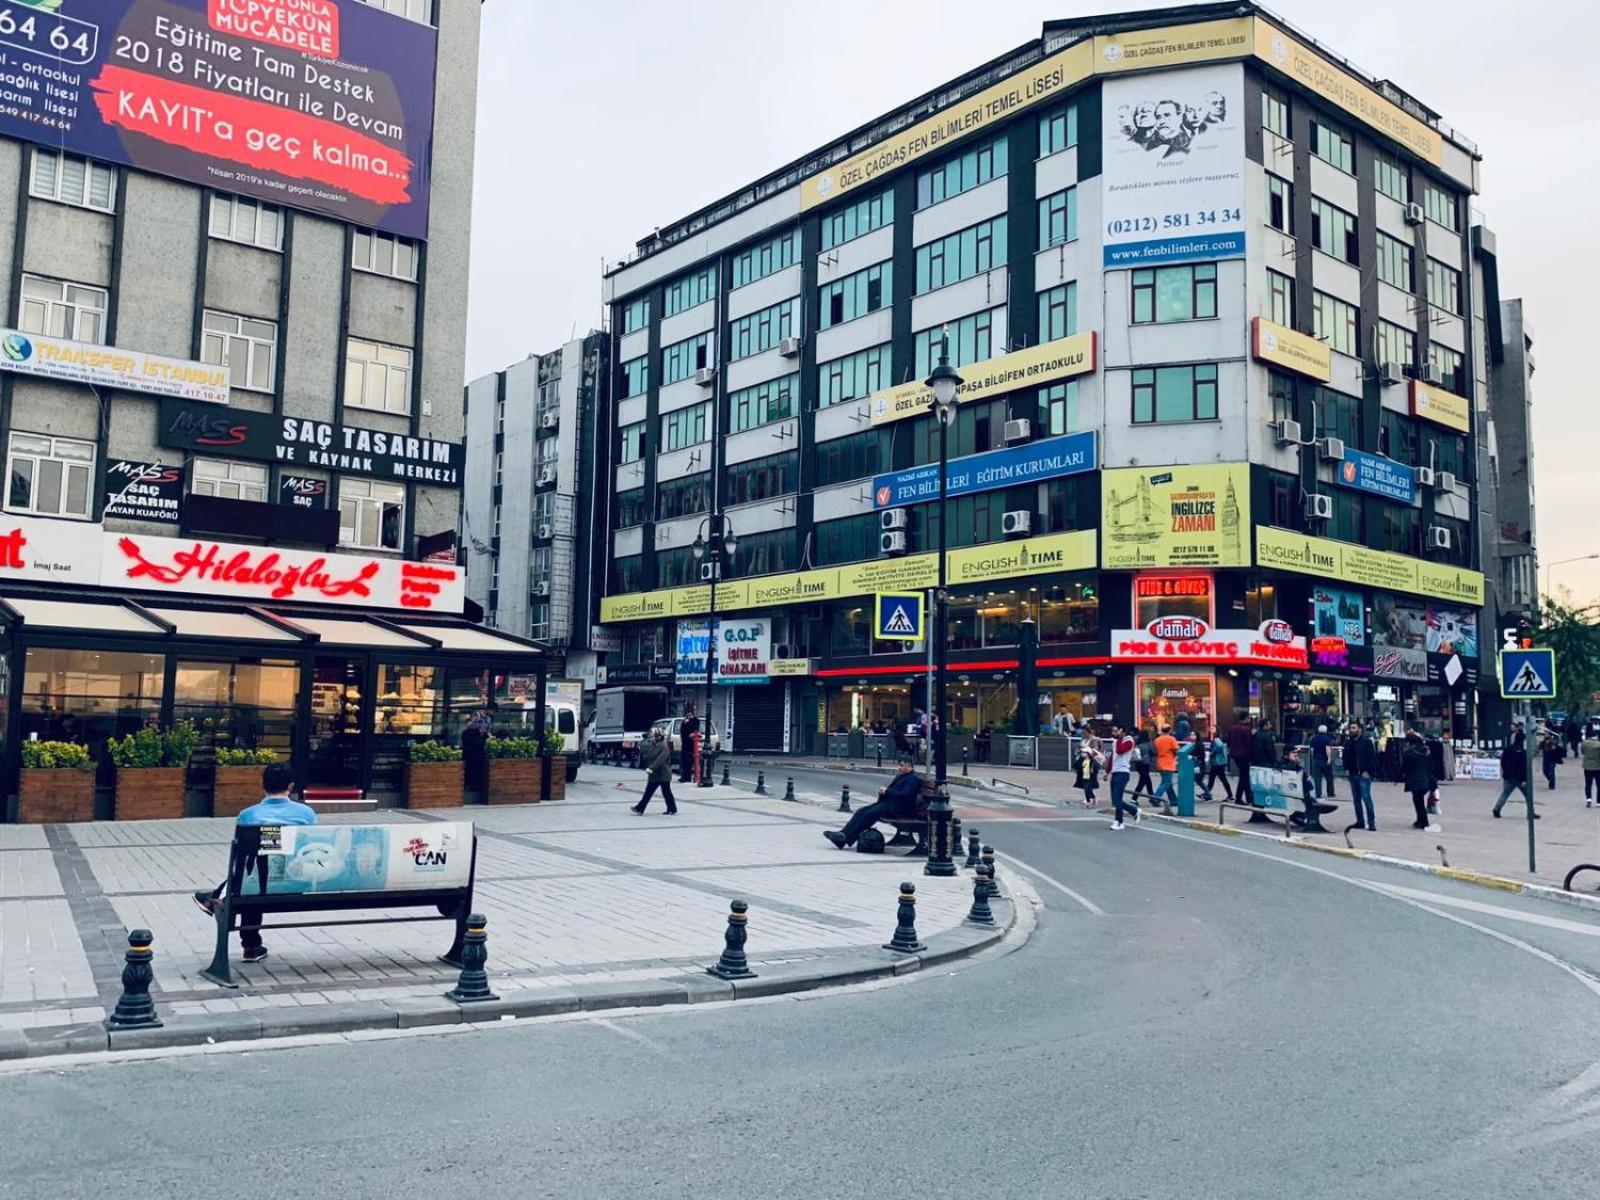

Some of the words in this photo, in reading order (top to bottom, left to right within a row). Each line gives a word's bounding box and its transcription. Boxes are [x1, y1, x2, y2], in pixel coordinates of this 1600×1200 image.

[50, 25, 88, 57] 64
[215, 11, 332, 53] MÜCADELE
[156, 16, 242, 62] Eğitime
[252, 47, 295, 79] Tam
[304, 65, 375, 104] Destek
[22, 62, 80, 87] ortaokul
[46, 82, 79, 103] lisesi
[116, 35, 184, 73] 2018
[194, 63, 290, 107] Fiyatları
[299, 92, 323, 117] ile
[333, 102, 403, 141] Devam
[21, 110, 40, 123] 417
[45, 98, 77, 118] lisesi
[119, 90, 233, 141] KAYIT'a
[245, 127, 301, 159] geç
[313, 142, 409, 181] kalma...
[839, 165, 863, 189] ÖZEL
[865, 145, 906, 177] ÇAĞDAŞ
[908, 131, 928, 157] FEN
[930, 104, 983, 148] BİLİMLERİ
[985, 90, 1024, 120] TEMEL
[1026, 64, 1064, 105] LİSESİ
[1107, 216, 1157, 236] (0212)
[1163, 212, 1190, 229] 581
[1196, 210, 1216, 225] 34
[1221, 208, 1241, 223] 34
[1111, 240, 1237, 260] www.fenbilimleri.com
[35, 341, 137, 372] TRANSFER
[895, 396, 915, 412] ÖZEL
[915, 379, 983, 409] GAZİNPAŞA
[984, 370, 1025, 390] BİLGİFEN
[1027, 353, 1084, 379] ORTAOKULU
[283, 418, 333, 450] SAÇ
[342, 427, 451, 464] TASARIM
[107, 459, 181, 484] MASS
[275, 445, 295, 461] VE
[309, 450, 373, 472] KAYNAK
[393, 461, 458, 484] MERKEZİ
[1361, 465, 1375, 479] FEN
[282, 476, 325, 495] MASS
[898, 484, 918, 500] FEN
[977, 466, 1014, 485] EĞİTİM
[1015, 452, 1085, 480] KURUMLARI
[107, 492, 180, 510] TASARIM
[128, 484, 160, 499] SAÇ
[292, 495, 313, 508] SAÇ
[136, 507, 179, 521] KUAFÖRÜ
[1171, 515, 1216, 533] ZAMANI
[962, 556, 1018, 574] ENGLISH
[1030, 550, 1063, 565] TIME
[1259, 543, 1303, 562] ENGLISH
[1312, 552, 1334, 567] TIME
[53, 563, 72, 573] Saat
[173, 543, 327, 598] Hilaloğlu
[756, 586, 794, 601] ENGLISH
[804, 582, 826, 595] TIME
[1422, 575, 1456, 592] ENGLISH
[1462, 583, 1479, 597] TIME
[611, 604, 642, 616] ENGLISH
[646, 602, 664, 612] TIME
[1156, 620, 1199, 638] damak
[728, 647, 759, 661] İŞİTME
[720, 661, 767, 675] CİHAZLARI
[1162, 687, 1188, 698] damak
[415, 851, 447, 866] CAN
